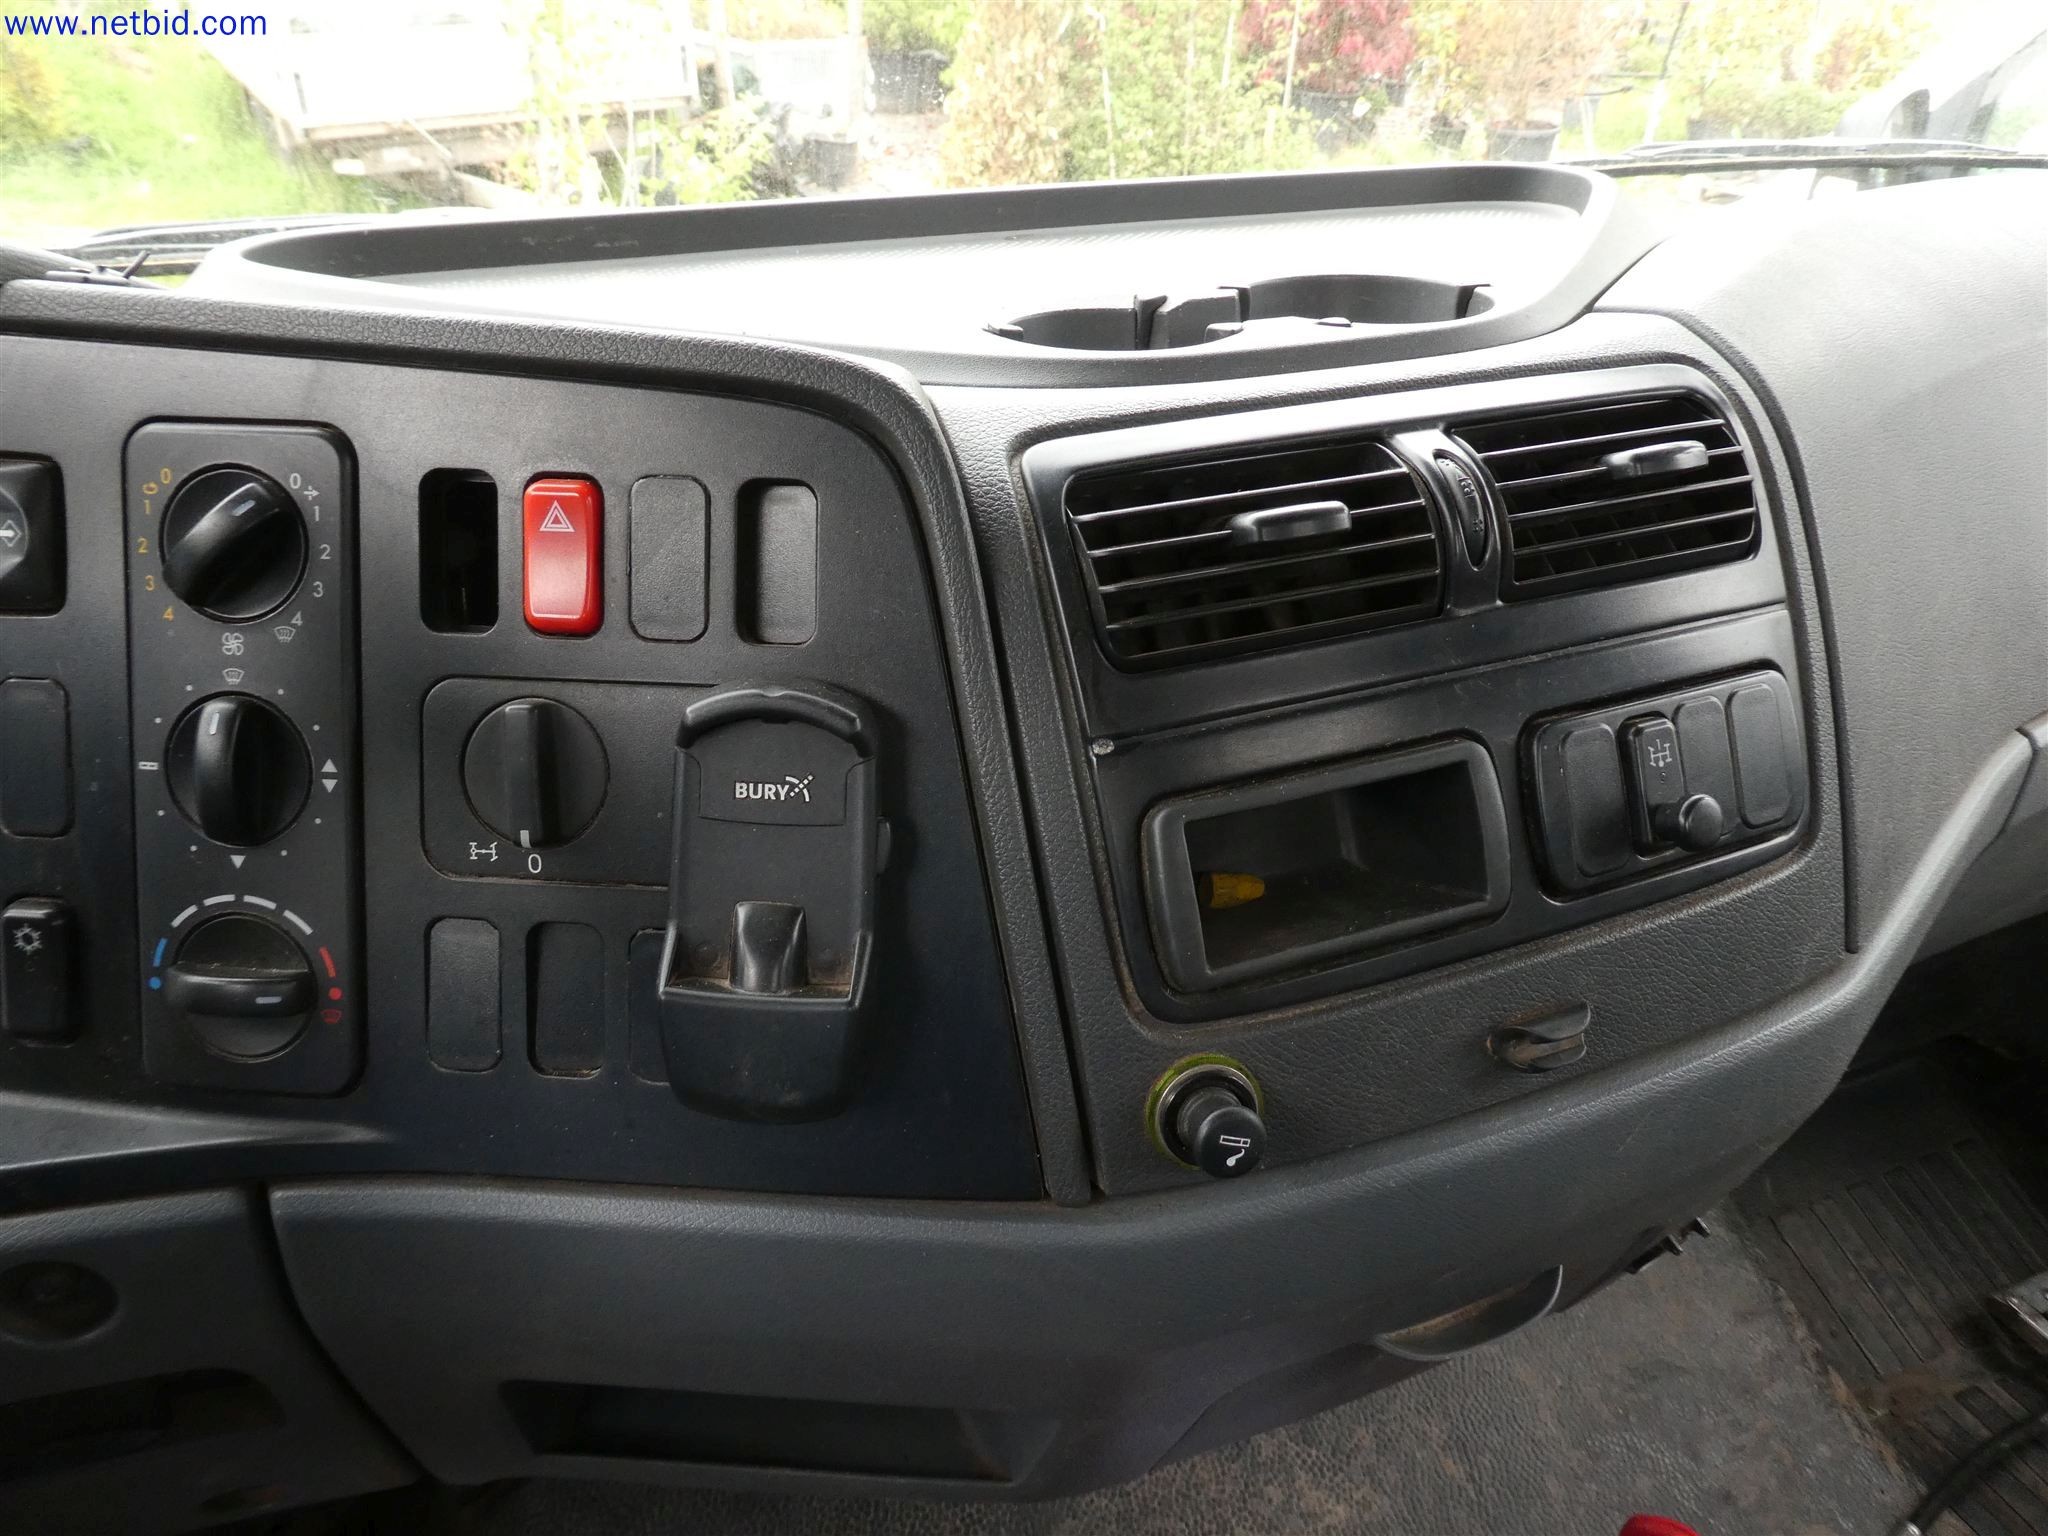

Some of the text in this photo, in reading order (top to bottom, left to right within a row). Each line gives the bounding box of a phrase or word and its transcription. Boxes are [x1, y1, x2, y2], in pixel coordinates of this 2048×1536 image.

[160, 468, 172, 484] 0
[290, 473, 302, 489] 0
[143, 500, 151, 515] 1
[313, 506, 320, 522] 1
[137, 538, 148, 553] 2
[319, 544, 331, 560] 2
[145, 575, 155, 591] 3
[313, 581, 324, 598] 3
[163, 606, 174, 622] 4
[291, 611, 303, 627] 4
[735, 782, 790, 801] BURY
[528, 853, 542, 874] 0
